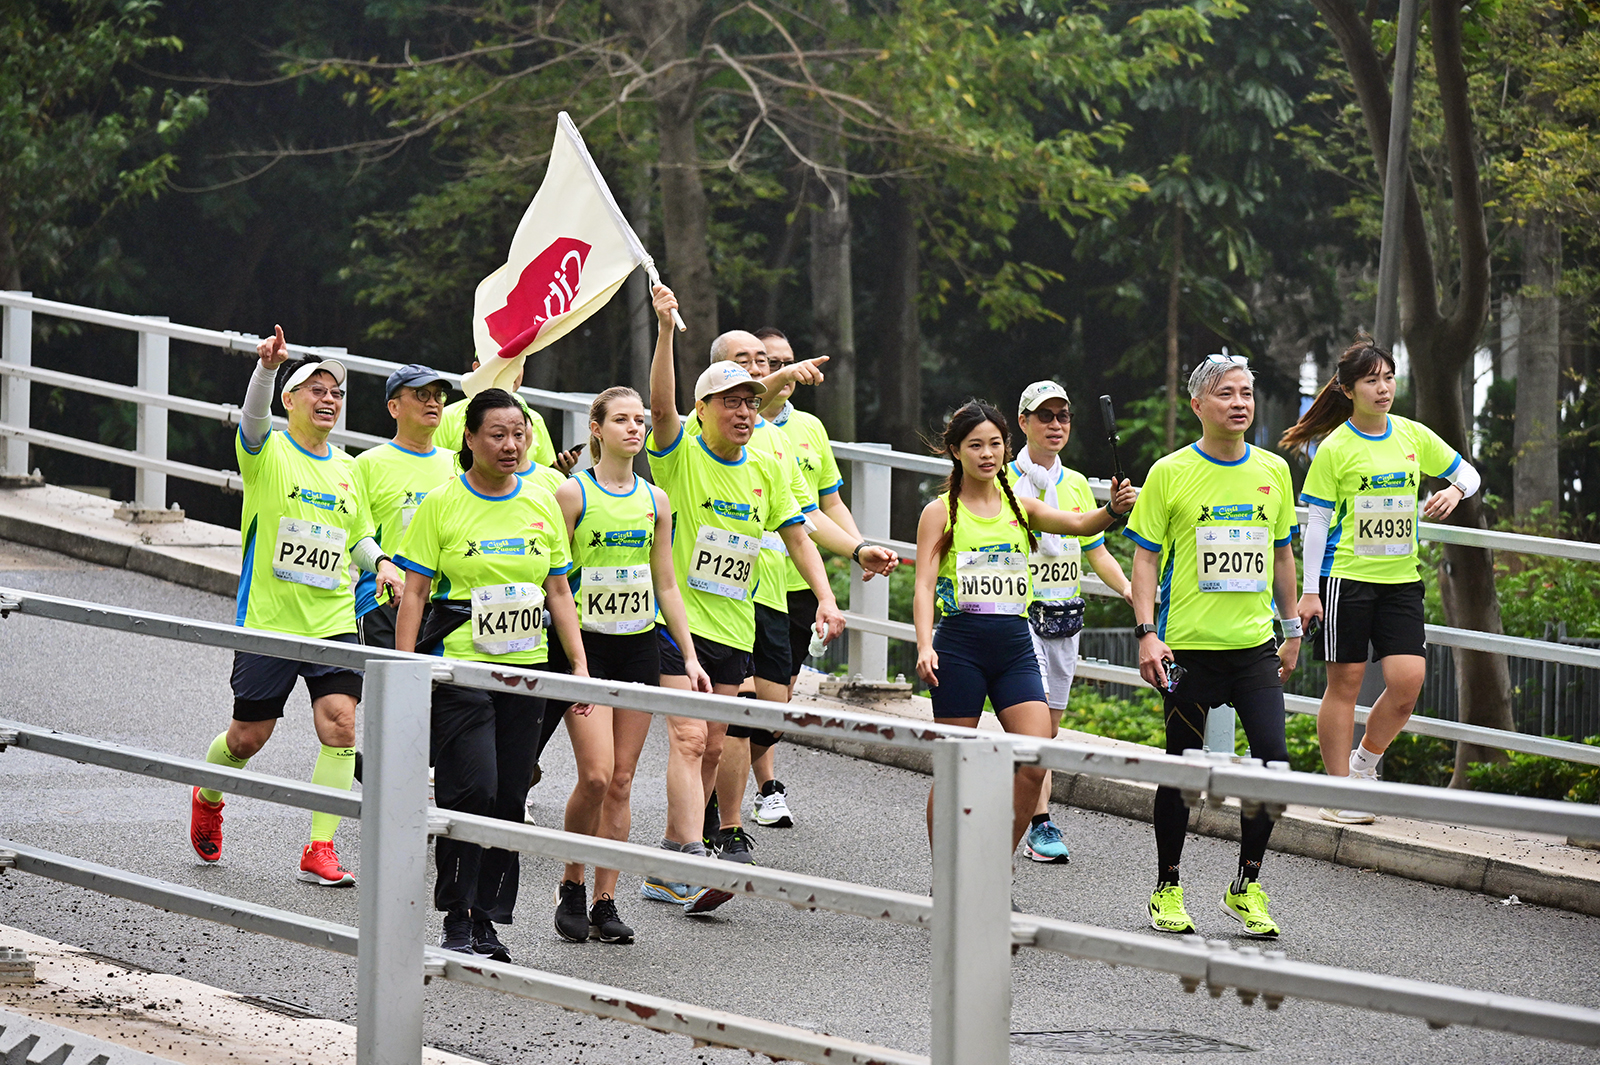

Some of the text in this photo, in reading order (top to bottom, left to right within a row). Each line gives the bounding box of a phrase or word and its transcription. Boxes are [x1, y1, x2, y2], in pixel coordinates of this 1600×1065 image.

[1359, 517, 1413, 539] K4939
[279, 541, 341, 572] P2407
[695, 549, 751, 583] P1239
[1203, 551, 1264, 574] P2076
[1029, 561, 1078, 583] P2620
[961, 575, 1027, 597] M5016
[588, 590, 649, 615] K4731
[478, 606, 541, 636] K4700
